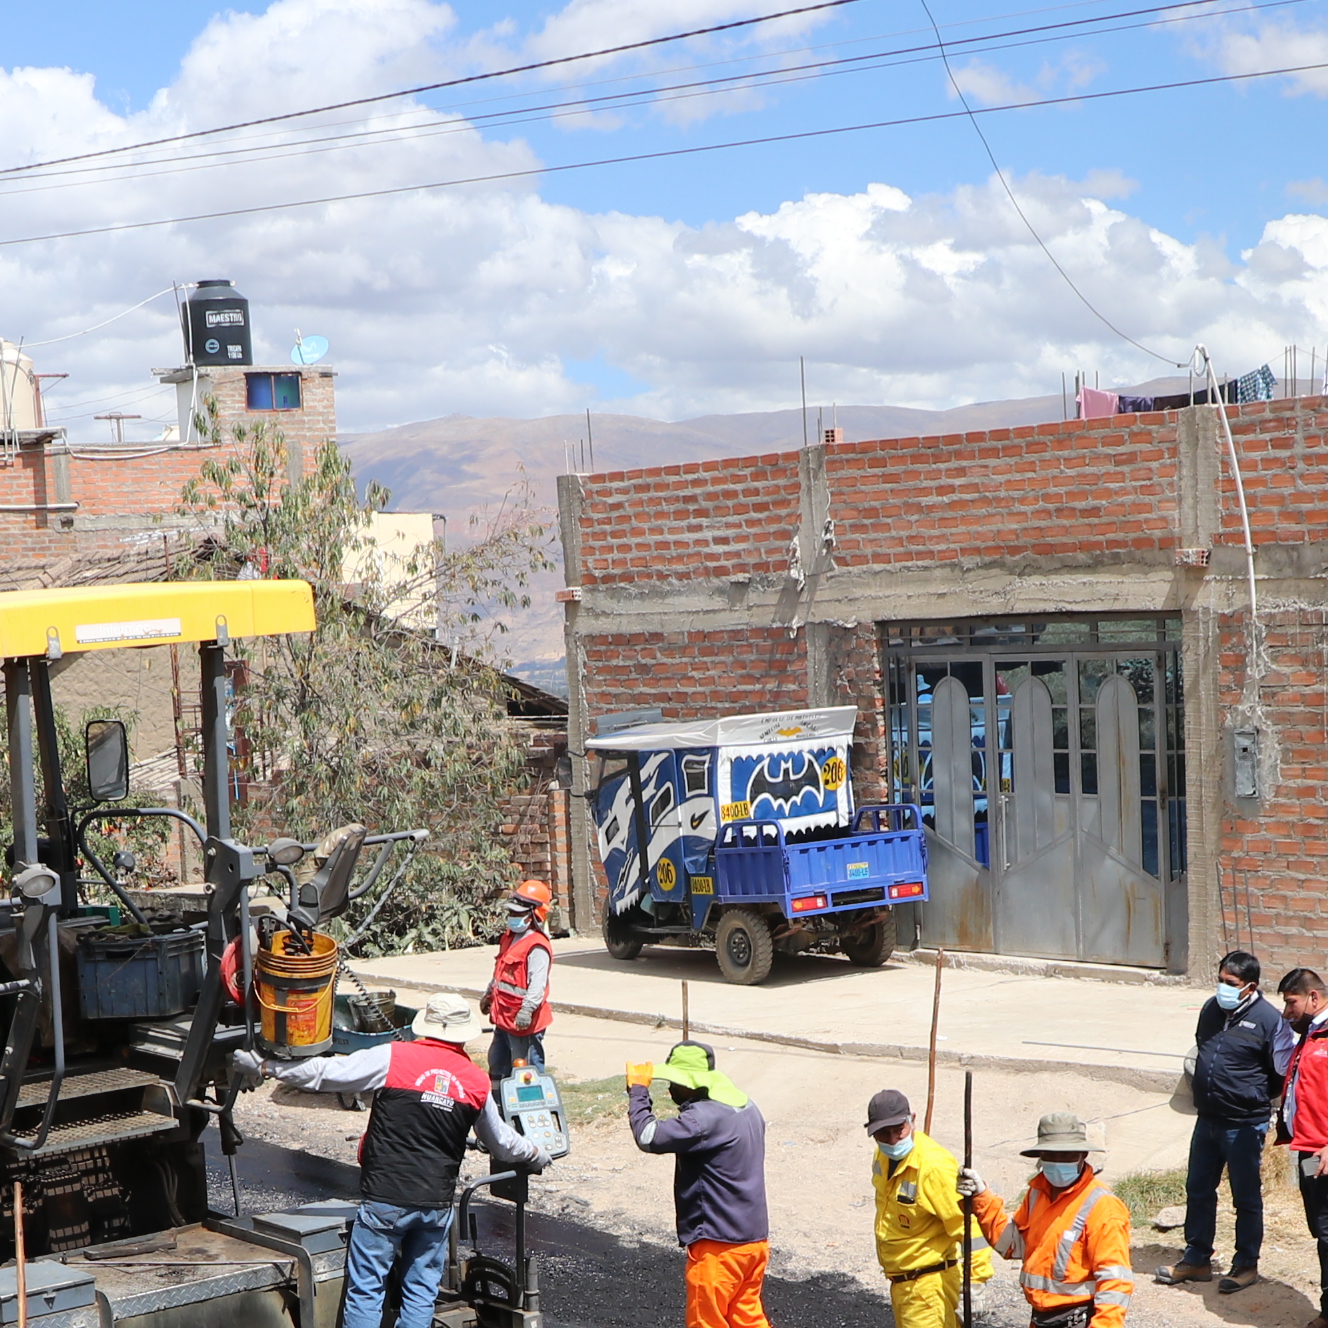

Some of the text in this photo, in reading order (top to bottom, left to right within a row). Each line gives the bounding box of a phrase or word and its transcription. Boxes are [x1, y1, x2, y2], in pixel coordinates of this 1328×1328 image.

[208, 313, 242, 323] MAESTRO
[823, 760, 844, 785] 206
[658, 862, 673, 884] 206
